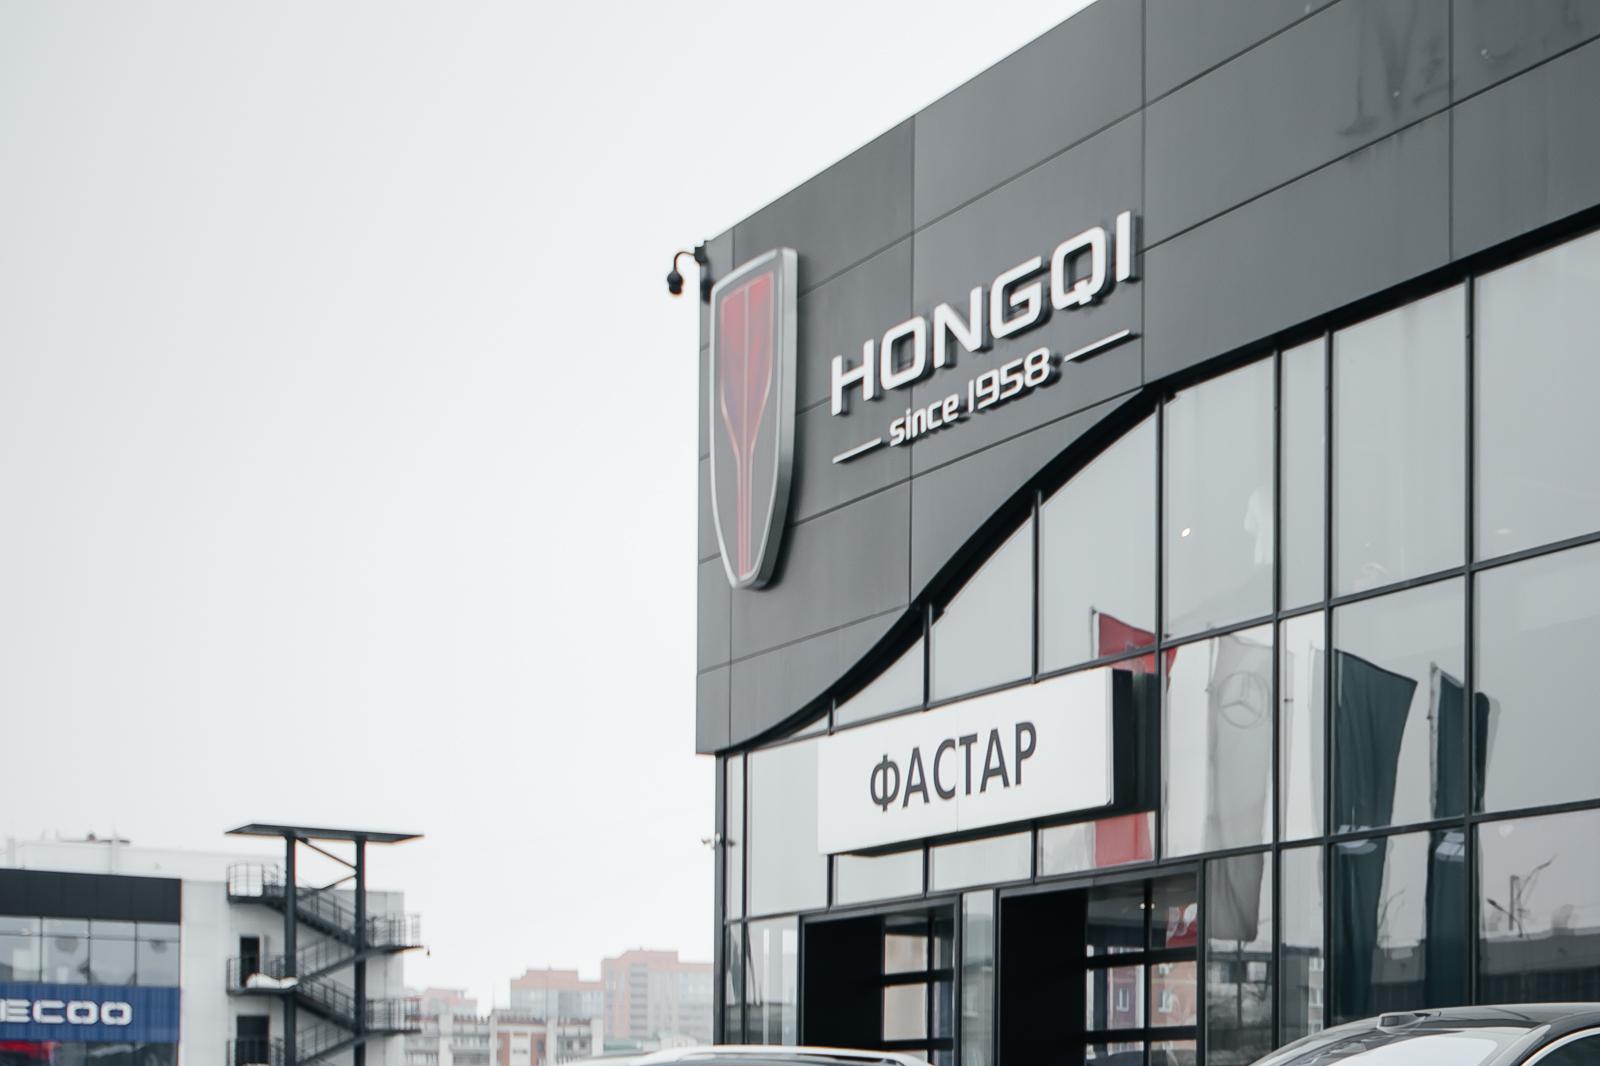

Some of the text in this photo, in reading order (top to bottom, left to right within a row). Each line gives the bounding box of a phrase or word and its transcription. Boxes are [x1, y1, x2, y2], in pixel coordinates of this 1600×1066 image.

[831, 210, 1137, 417] HONGQI
[889, 346, 1052, 448] since 1958
[869, 721, 1037, 812] ФАСТАР
[0, 998, 133, 1026] ECOO
